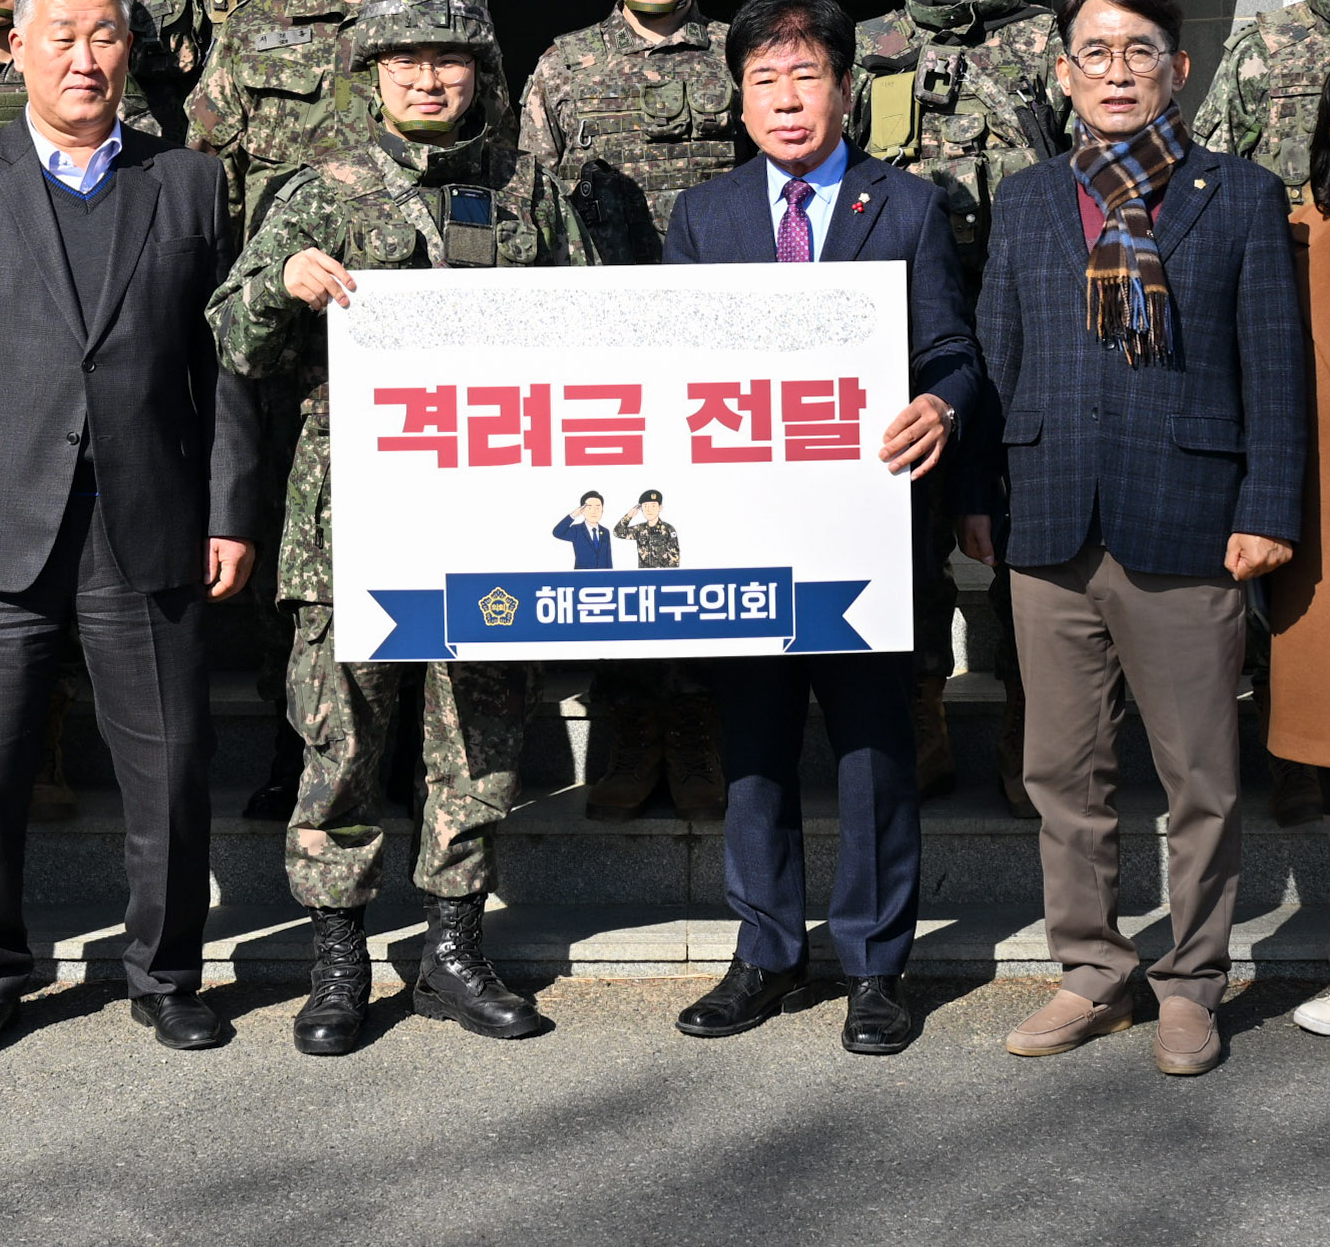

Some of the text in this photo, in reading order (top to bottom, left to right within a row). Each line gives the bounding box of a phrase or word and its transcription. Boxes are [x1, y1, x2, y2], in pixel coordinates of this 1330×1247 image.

[374, 377, 866, 468] 격려금 전달
[536, 582, 776, 624] 해운대구의회
